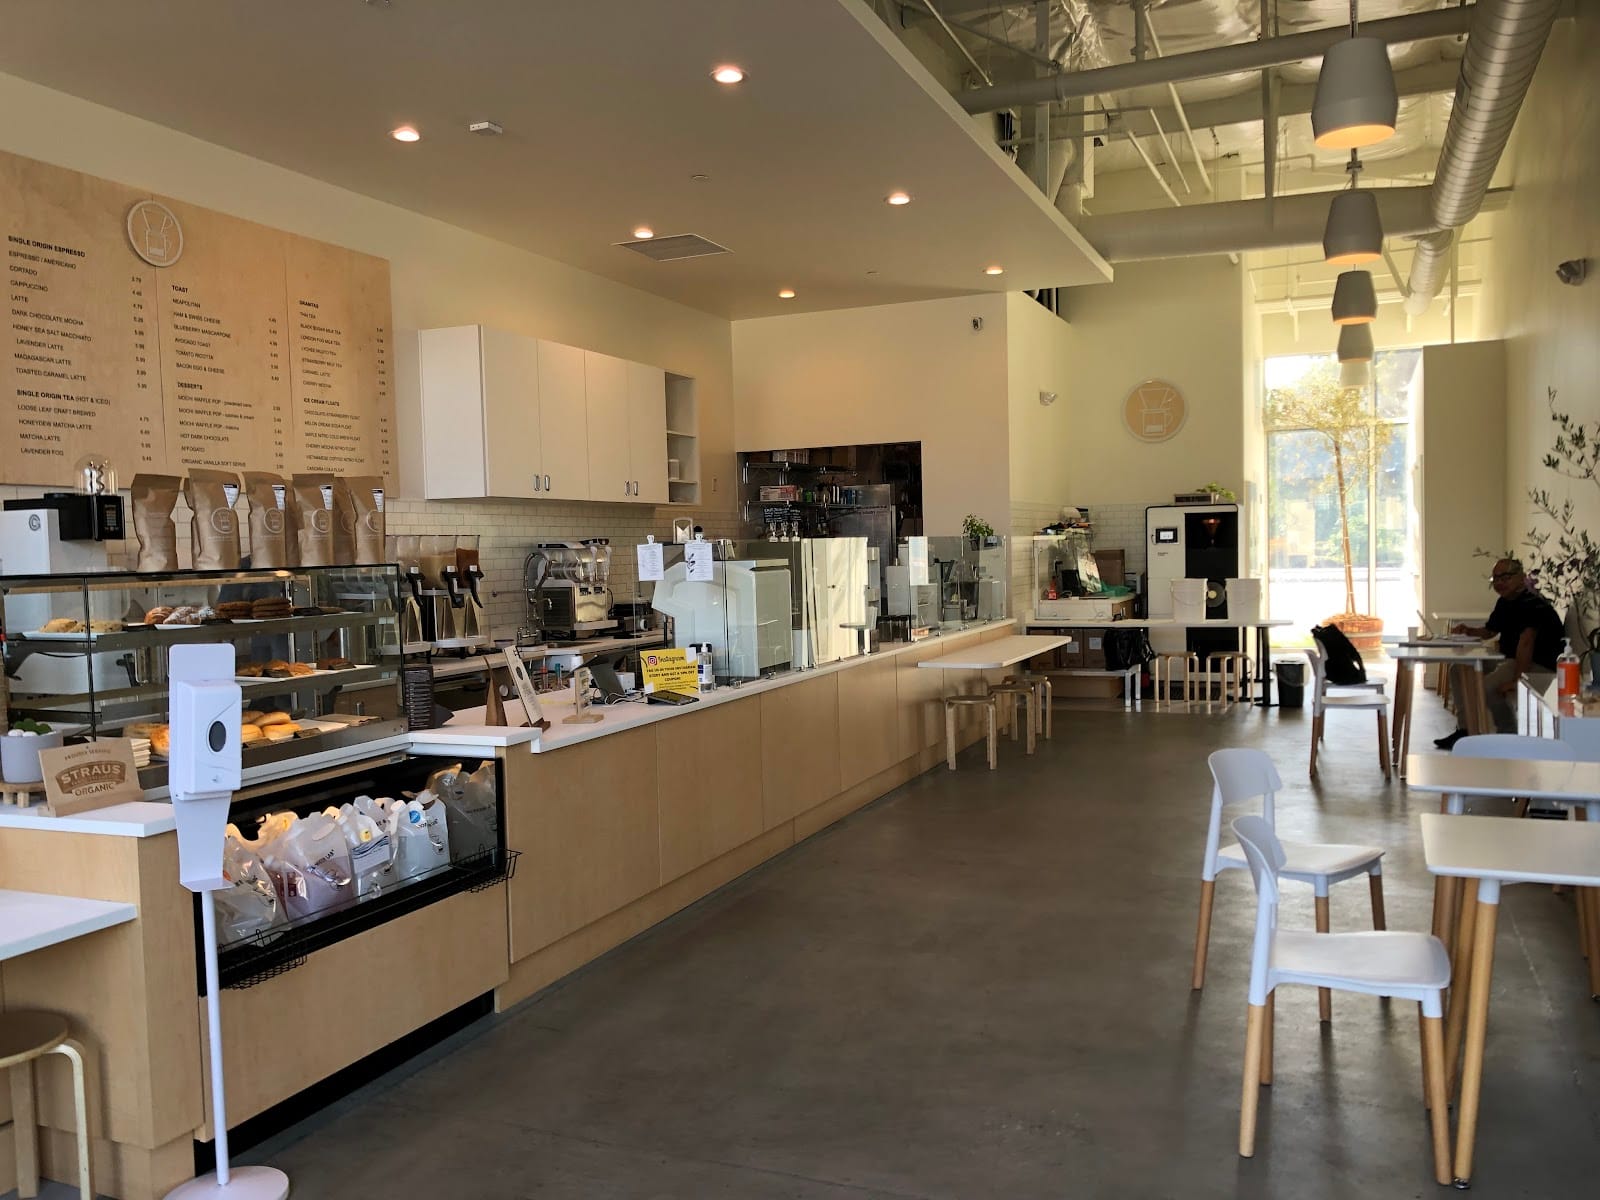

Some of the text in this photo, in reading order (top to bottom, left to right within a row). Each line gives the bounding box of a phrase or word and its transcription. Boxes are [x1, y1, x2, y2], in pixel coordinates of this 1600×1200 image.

[8, 235, 85, 257] SINGLE ORIGIN ESPRESSO
[9, 250, 39, 262] ESPRESSO
[44, 257, 76, 269] AMERICANO
[10, 265, 37, 276] CORTADO
[10, 280, 48, 292] CAPPUCCINO
[172, 285, 188, 293] TOAST
[173, 299, 200, 308] NEAPOLITAN
[29, 312, 62, 322] CHOCOLATE
[64, 317, 83, 325] MOCHA
[13, 324, 32, 332] HONEY
[61, 332, 91, 341] MACCHIATO
[174, 324, 231, 338] BLUEBERRY MASCARPONE
[17, 338, 63, 351] LAVENDER LATTE
[15, 353, 54, 363] MADAGASCAR
[195, 352, 213, 360] RICOTTA
[176, 362, 192, 370] BACON
[16, 368, 42, 376] TOASTED
[43, 371, 69, 379] CARAMEL
[177, 382, 202, 390] DESSERTS
[41, 392, 61, 400] ORIGIN
[73, 409, 96, 417] BREWED
[19, 419, 51, 427] HONEYDEW
[61, 764, 121, 784] STRAUS
[75, 783, 114, 796] ORGANIC
